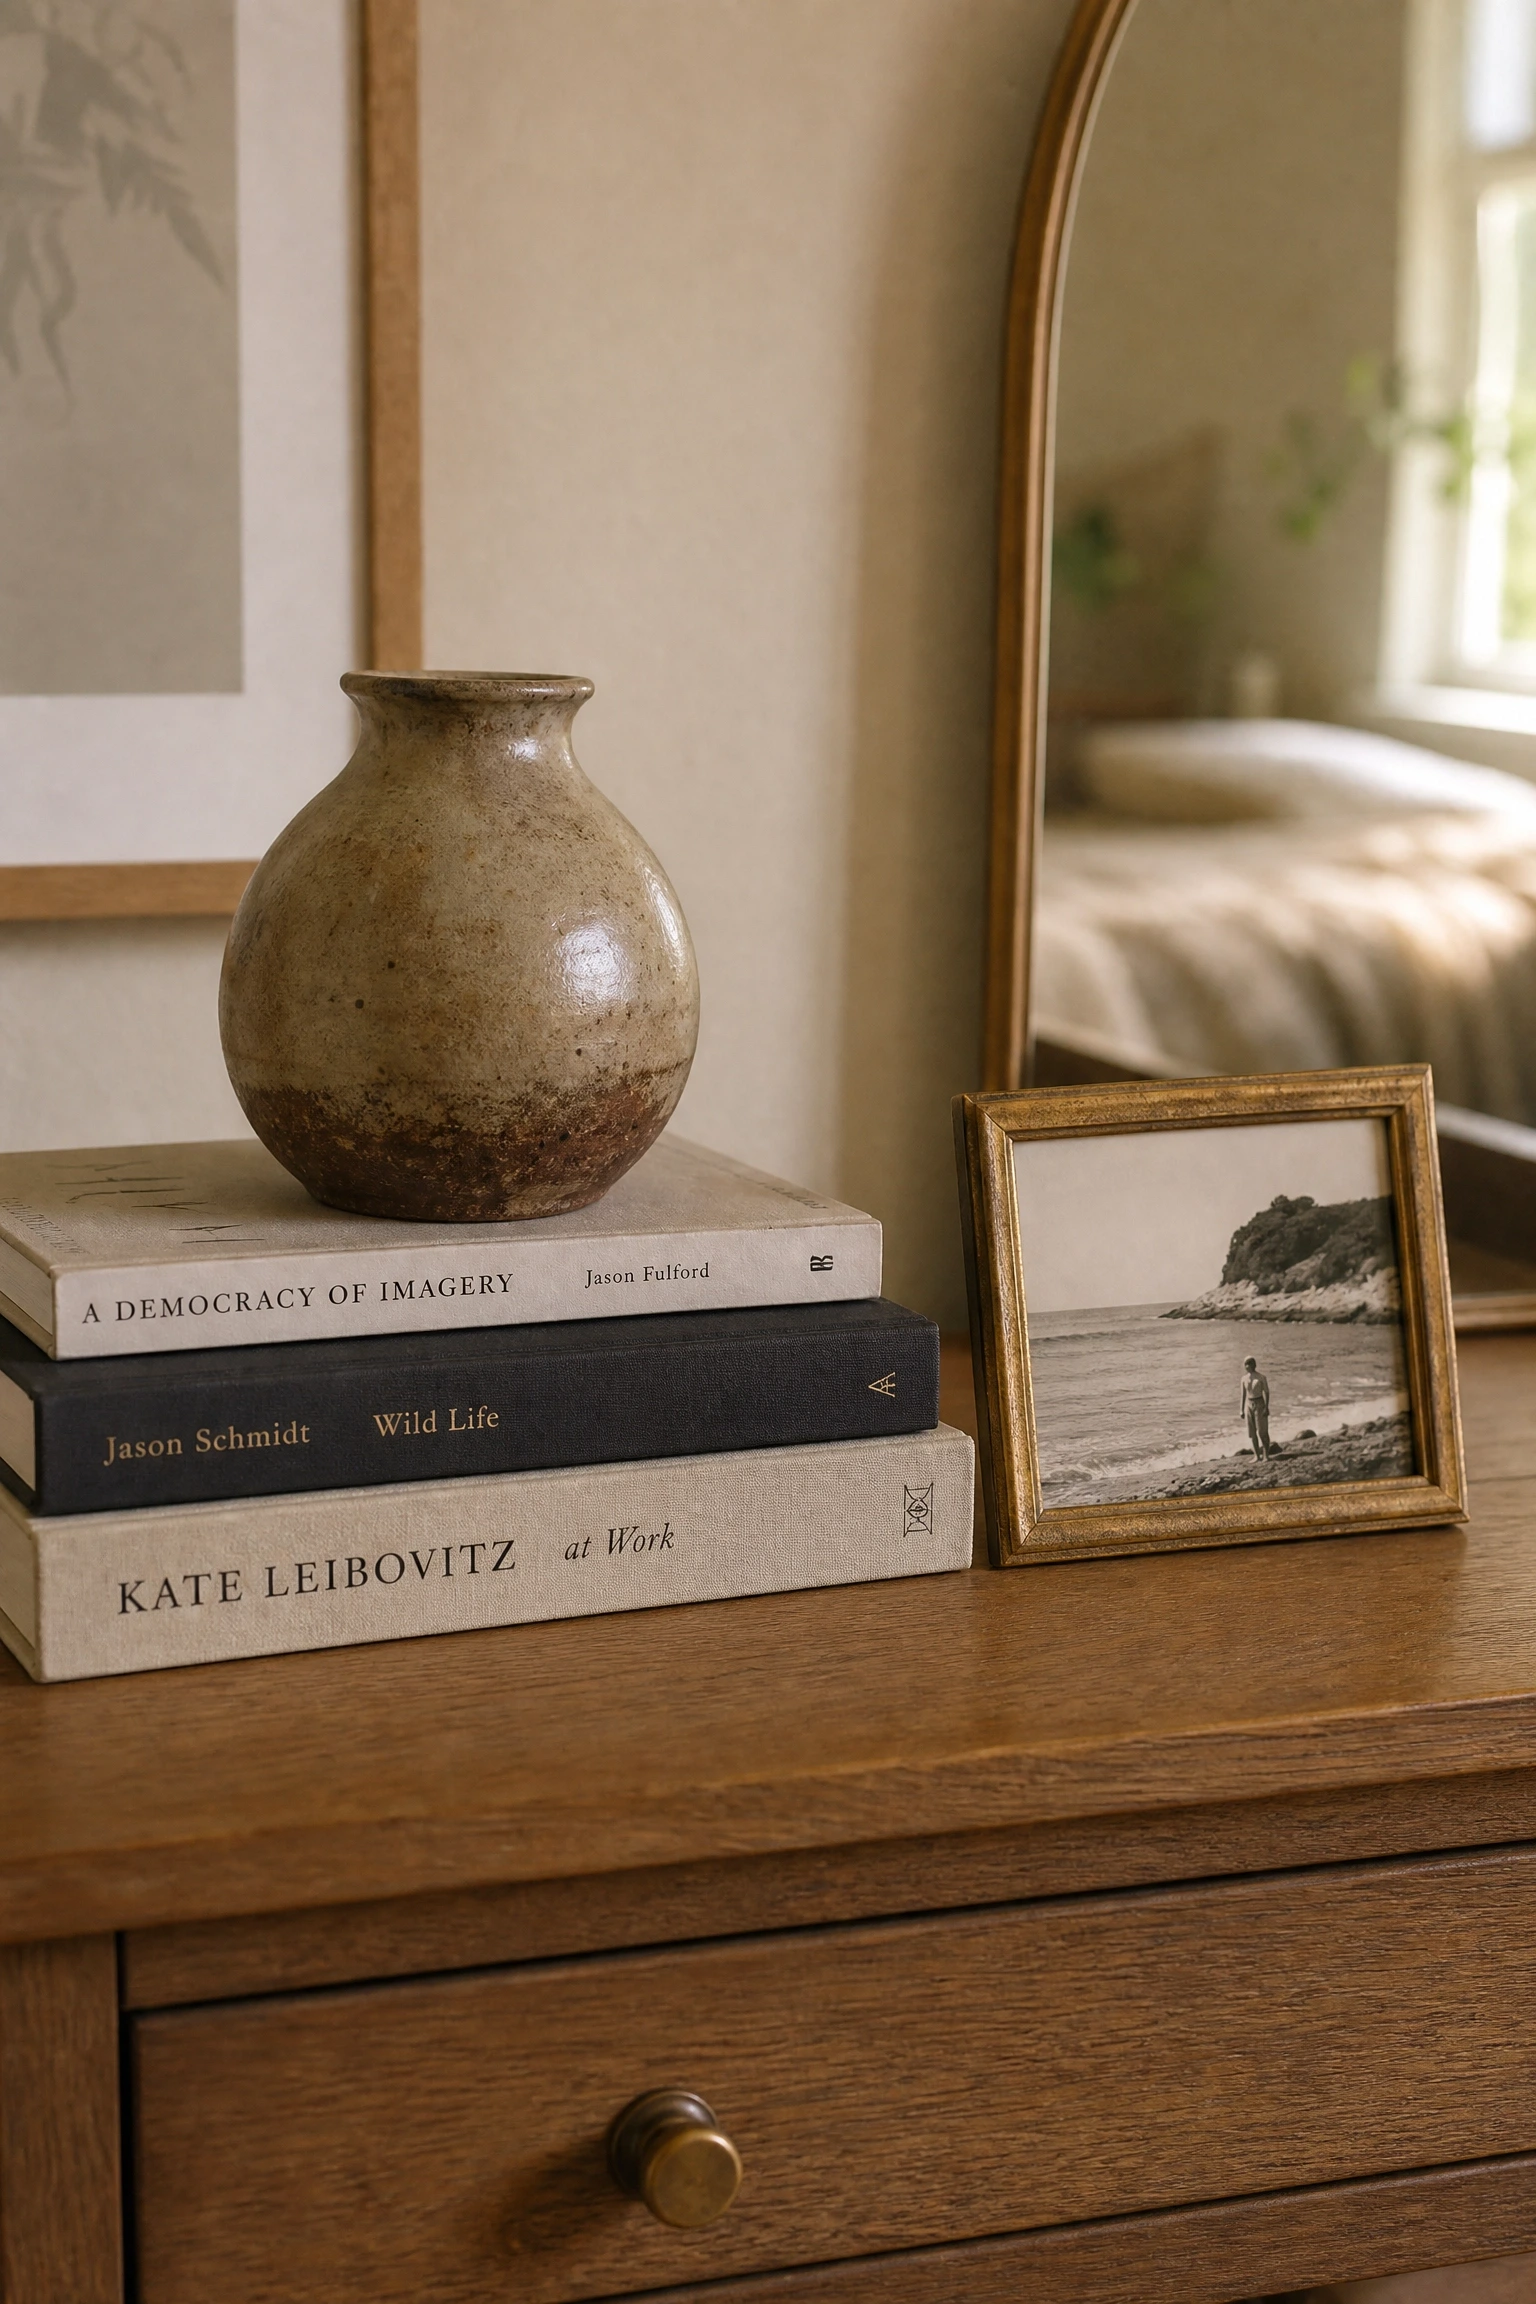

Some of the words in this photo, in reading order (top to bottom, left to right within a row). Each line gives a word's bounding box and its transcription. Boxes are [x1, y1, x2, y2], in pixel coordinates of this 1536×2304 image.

[584, 1269, 635, 1289] Jason
[642, 1261, 710, 1282] Fulford
[82, 1302, 101, 1324] A
[115, 1286, 316, 1322] DEMOCRACY
[328, 1283, 367, 1305] OF
[380, 1273, 514, 1302] IMAGERY
[372, 1409, 438, 1437] Wild
[448, 1405, 499, 1432] Life
[103, 1436, 183, 1467] Jason
[195, 1420, 311, 1453] Schmidt
[564, 1536, 592, 1561] at
[607, 1521, 675, 1556] Work
[117, 1569, 243, 1615] KATE
[264, 1539, 516, 1599] LEIBOVITZ
